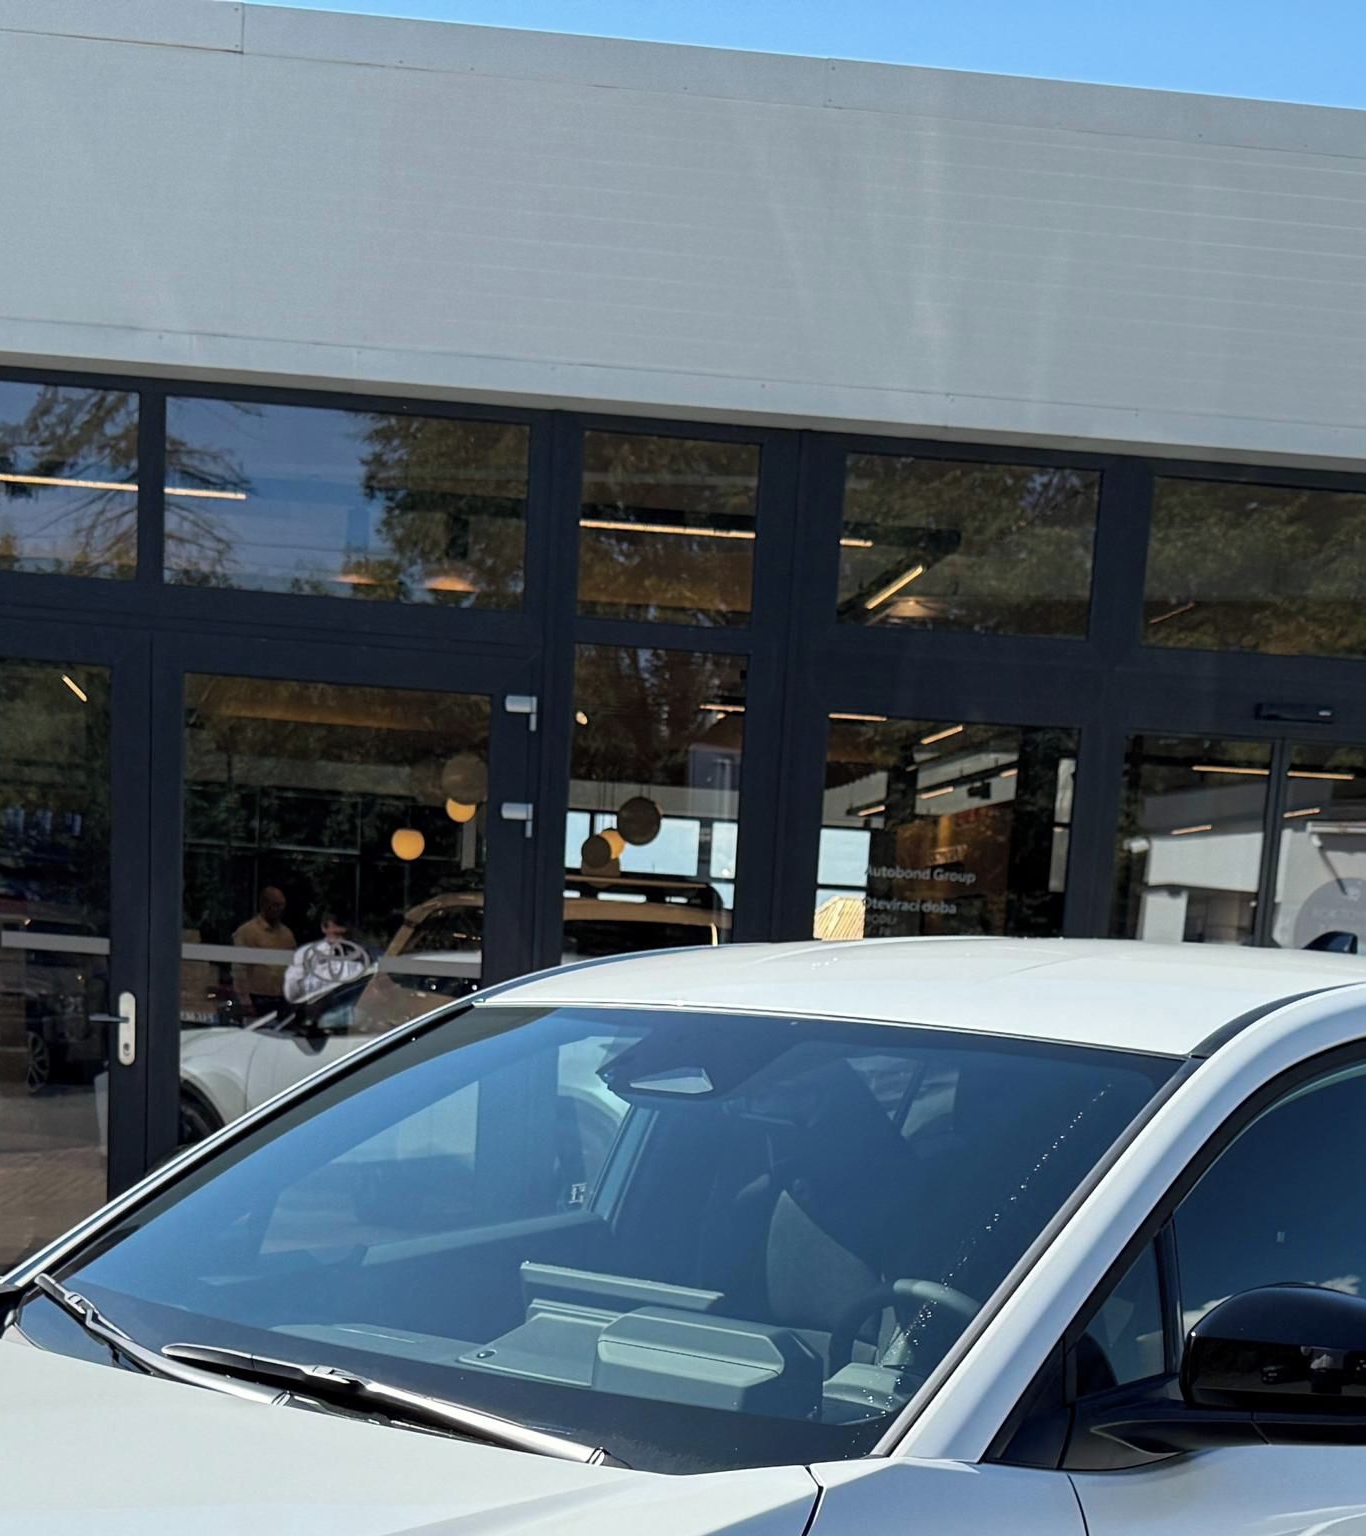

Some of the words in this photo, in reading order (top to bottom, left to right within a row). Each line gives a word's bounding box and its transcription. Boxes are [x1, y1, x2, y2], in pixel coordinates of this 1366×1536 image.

[865, 864, 931, 881] Autobond
[933, 868, 976, 886] Group
[922, 900, 957, 915] doba
